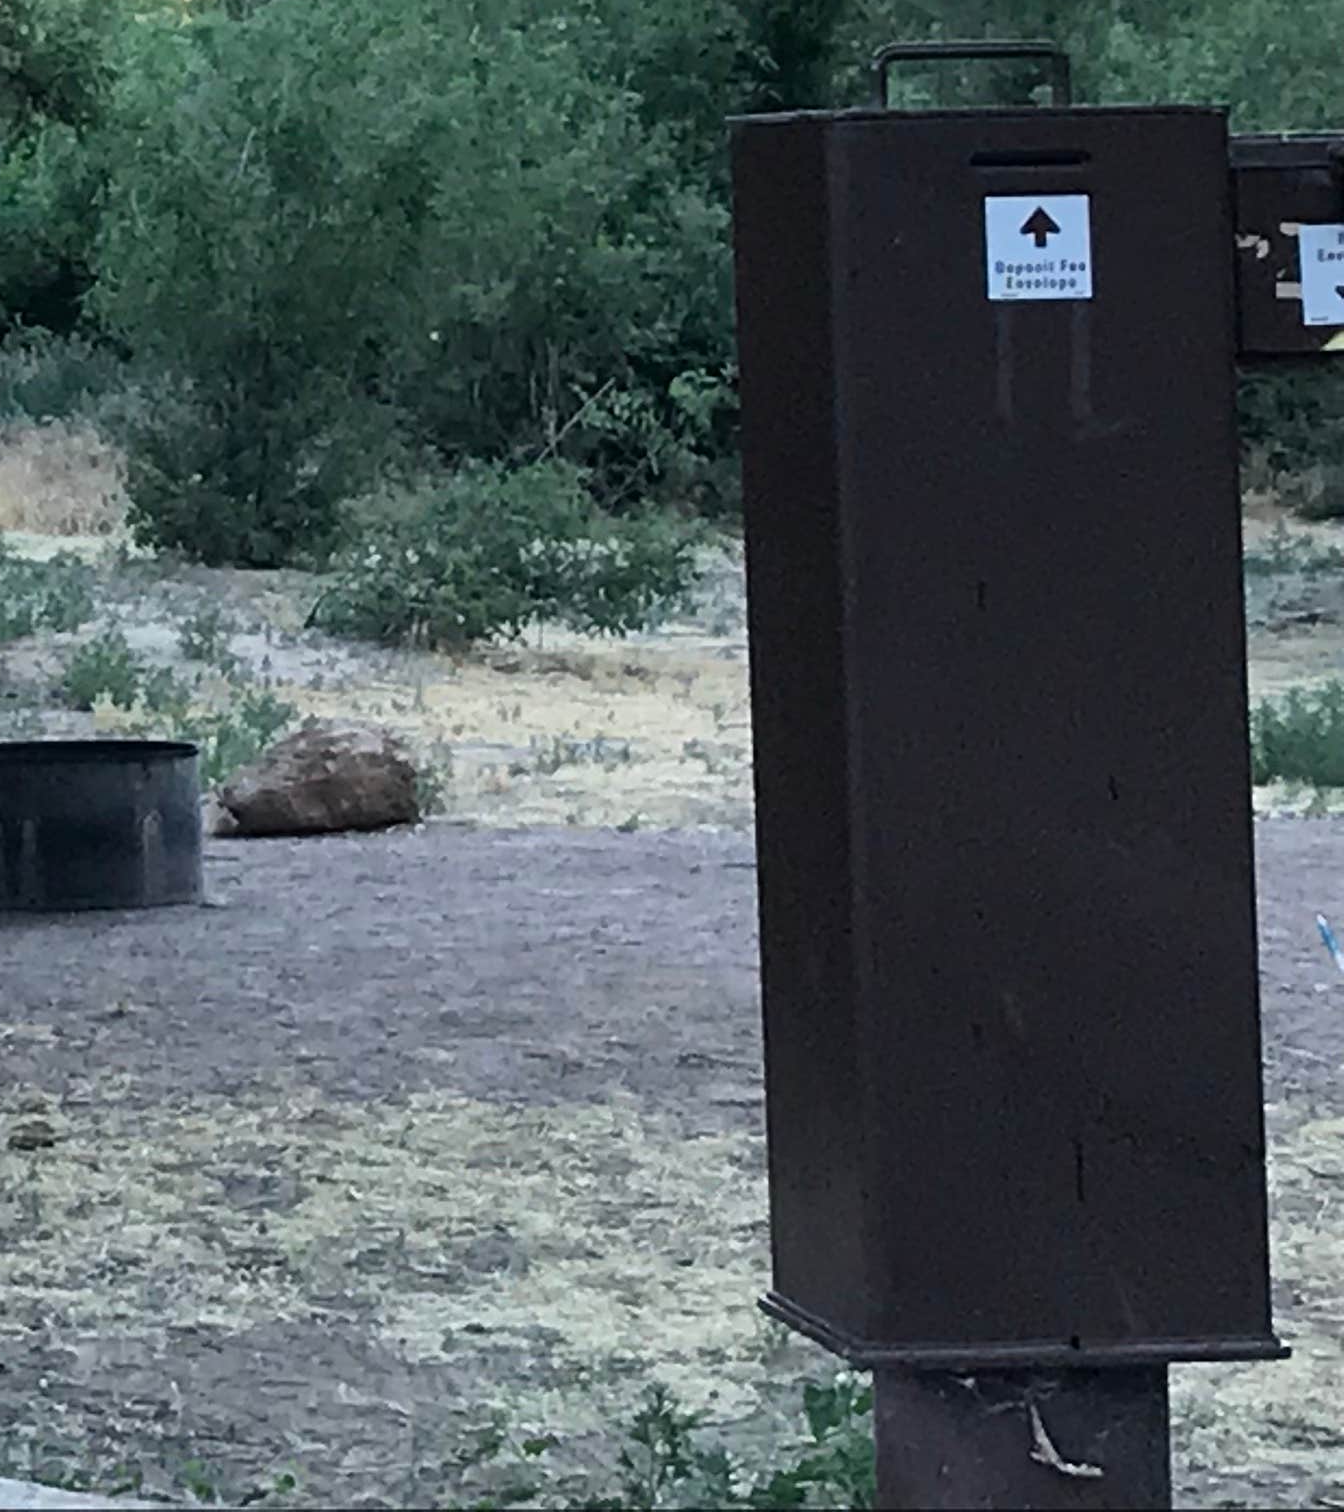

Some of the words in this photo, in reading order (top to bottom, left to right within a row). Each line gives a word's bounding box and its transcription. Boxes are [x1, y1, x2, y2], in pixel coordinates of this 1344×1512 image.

[995, 261, 1054, 275] Deposit
[1059, 259, 1086, 272] Fee
[1006, 276, 1077, 291] Envelope
